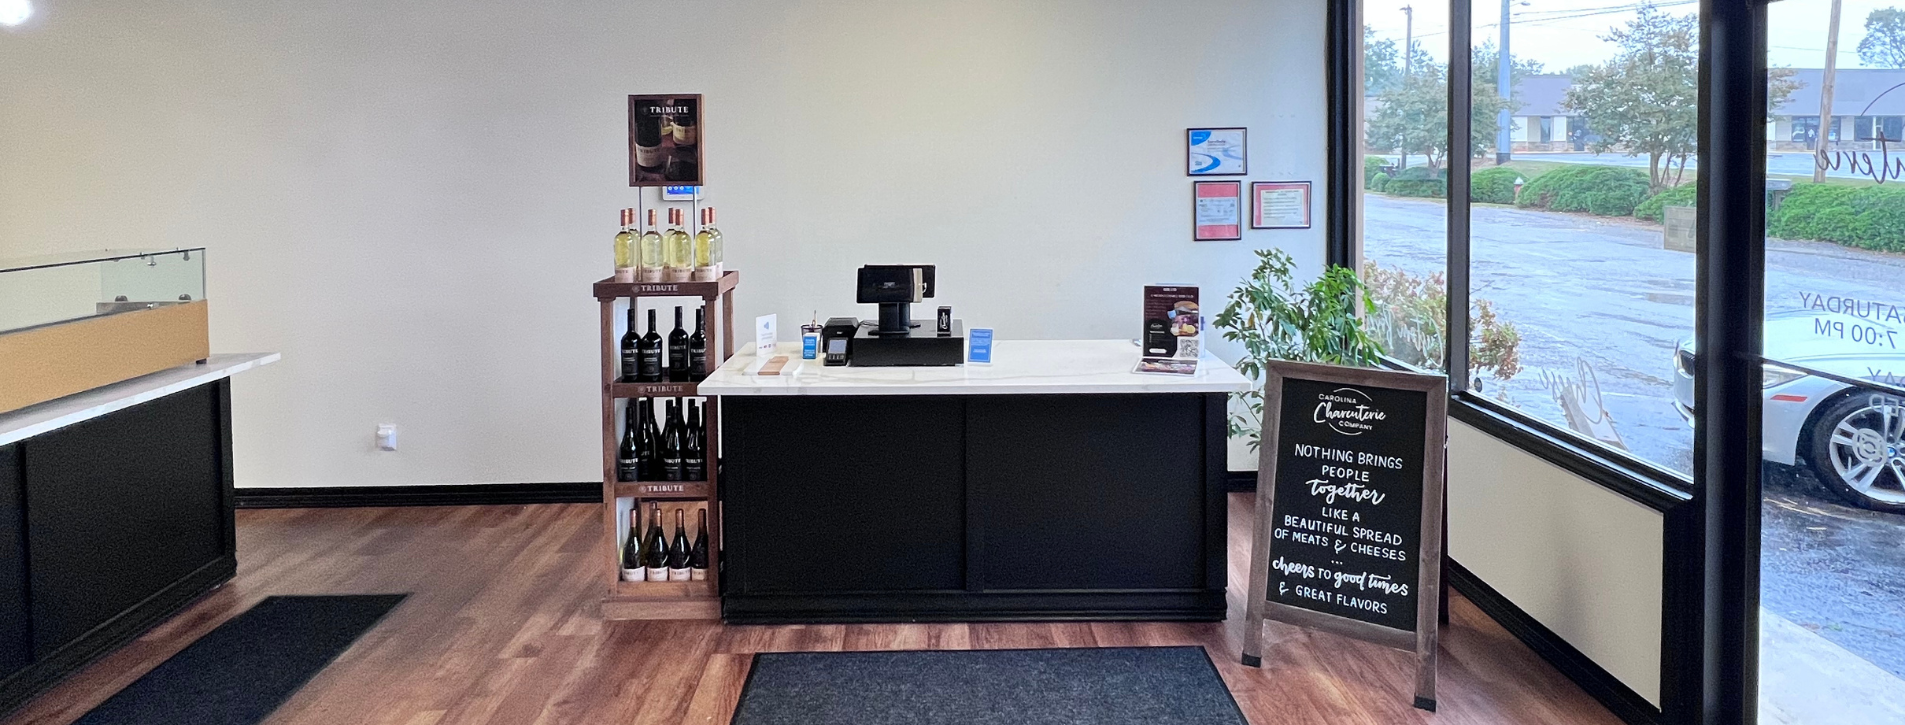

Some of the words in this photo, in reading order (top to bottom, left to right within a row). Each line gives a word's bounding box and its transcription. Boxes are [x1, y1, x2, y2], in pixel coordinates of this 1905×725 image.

[647, 385, 683, 393] TRIBUTE
[1318, 393, 1357, 404] CAROLINA
[1313, 401, 1386, 424] Charcuterie
[1338, 420, 1373, 431] COMPANY
[1294, 443, 1354, 463] NOTHING
[1357, 452, 1403, 470] BRINGS
[1321, 465, 1370, 482] PEOPLE
[1321, 506, 1349, 521] LIKE
[1352, 511, 1360, 522] A
[1284, 514, 1349, 536] BEAUTIFUL
[1352, 526, 1403, 546] SPREAD
[1274, 528, 1289, 540] OF
[1292, 532, 1329, 547] MEATS
[1333, 539, 1347, 554] &
[1350, 542, 1406, 561] CHEESES
[1272, 556, 1315, 579] cheers
[1318, 568, 1332, 580] TO
[1333, 571, 1367, 591] good
[1368, 573, 1409, 596] times
[1278, 581, 1289, 596] &
[1295, 584, 1333, 603] GREAT
[1336, 593, 1388, 614] FLAVORS
